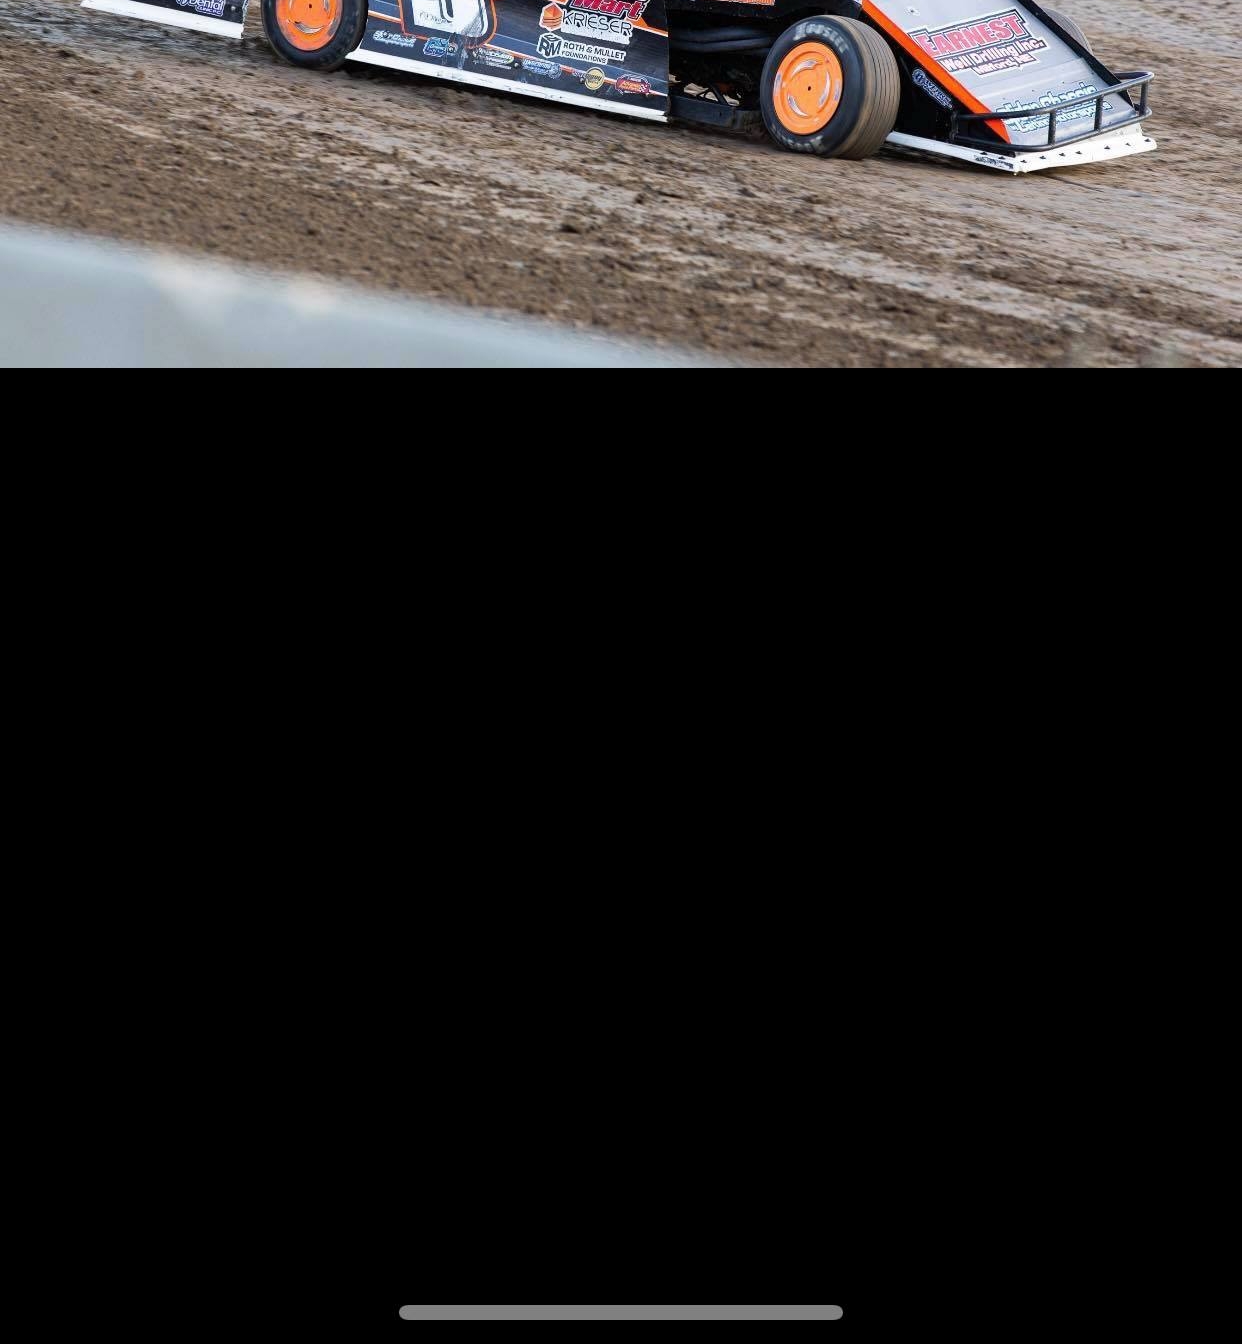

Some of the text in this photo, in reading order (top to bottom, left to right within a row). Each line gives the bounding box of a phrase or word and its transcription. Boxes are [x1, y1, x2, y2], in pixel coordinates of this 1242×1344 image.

[562, 10, 633, 37] KRIESER
[914, 13, 1026, 56] EARNEST
[561, 50, 607, 64] FOUNDATIONS
[563, 41, 586, 53] ROTH
[594, 46, 625, 60] MULLET
[938, 37, 1046, 72] Well Drilling Inc.
